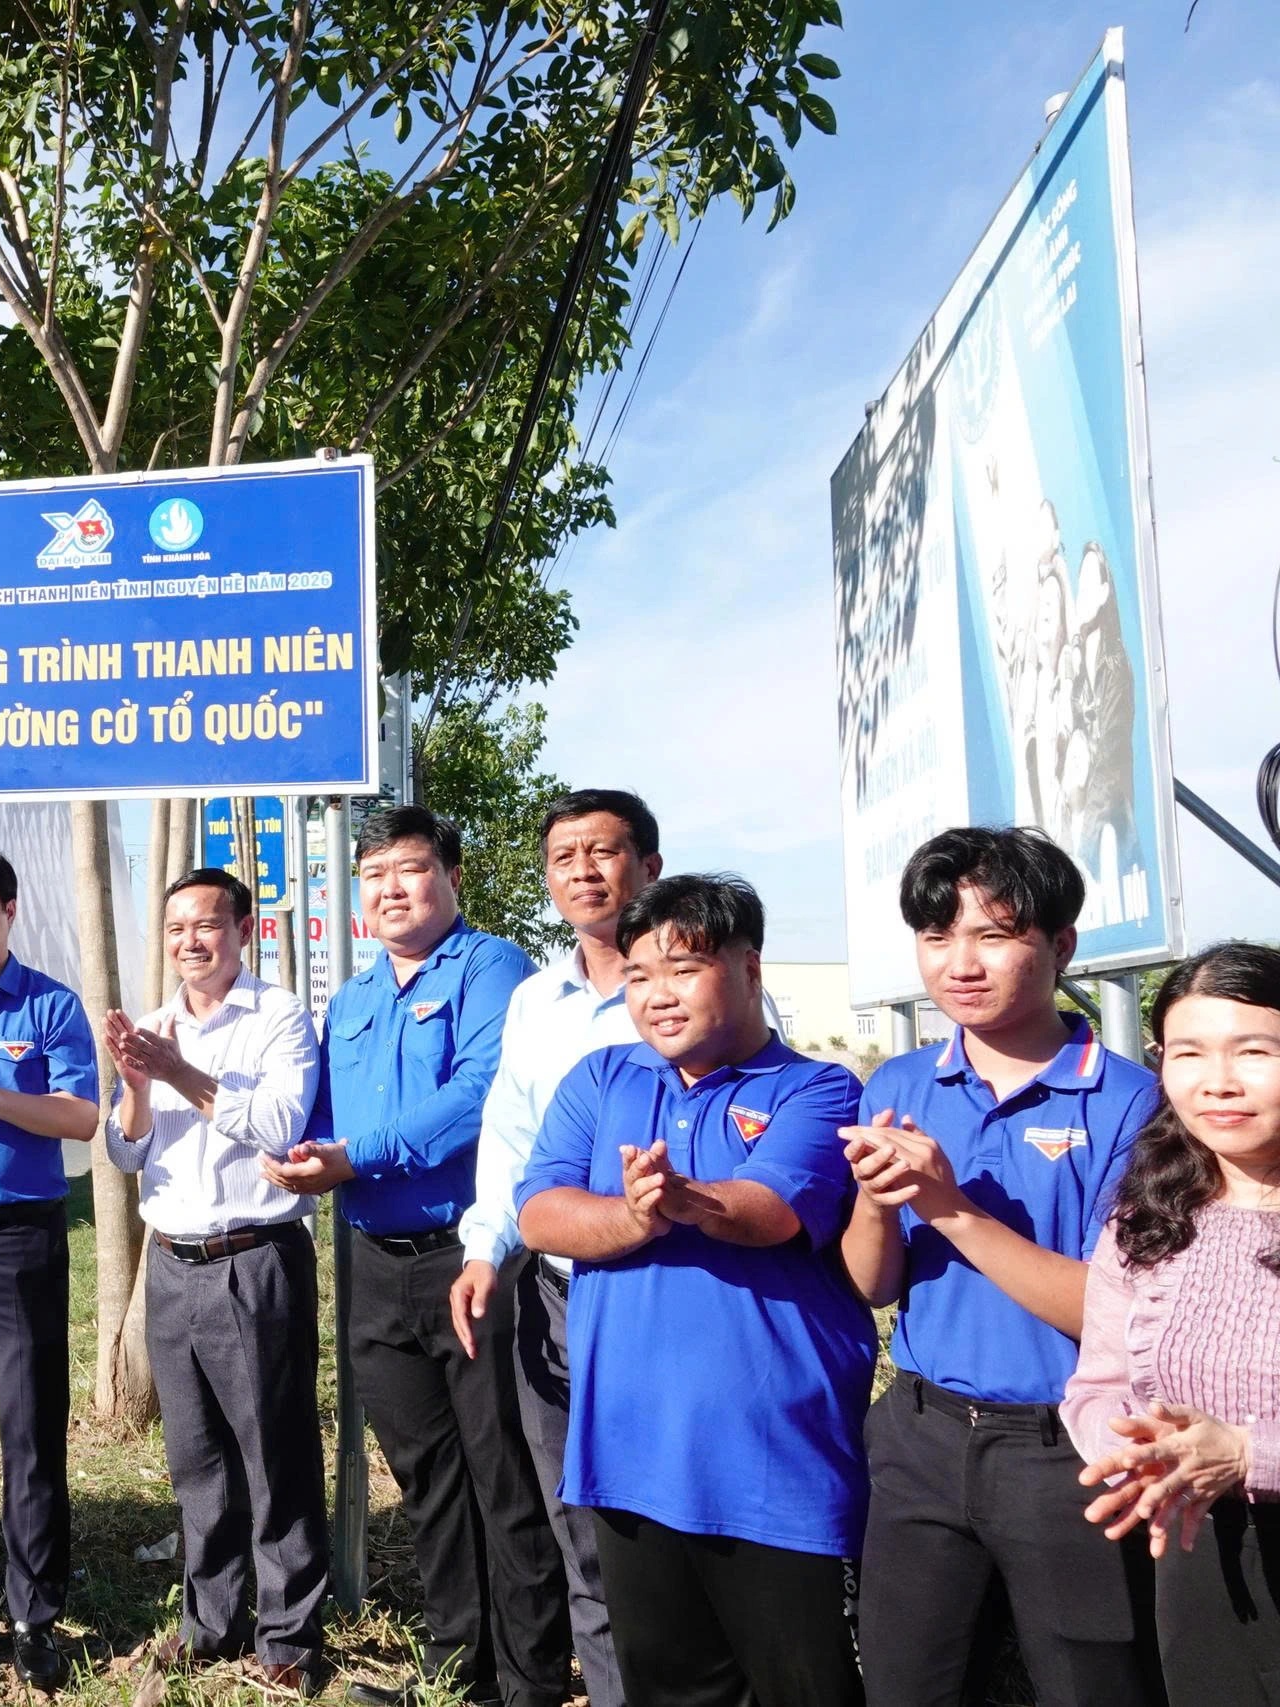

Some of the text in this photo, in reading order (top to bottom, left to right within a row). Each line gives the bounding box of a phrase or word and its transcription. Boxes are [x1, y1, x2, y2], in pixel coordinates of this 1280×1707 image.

[64, 555, 85, 567] HỘI
[89, 554, 110, 564] XIII
[163, 552, 191, 563] KHÁNH
[18, 586, 68, 603] THANH
[74, 581, 109, 599] NIÊN
[155, 576, 218, 598] NGUYỆN
[223, 573, 243, 592] HÈ
[249, 573, 284, 590] NĂM
[290, 573, 331, 589] 2026
[19, 637, 122, 682] TRÌNH
[133, 637, 252, 679] THANH
[264, 626, 354, 673] NIÊN
[91, 698, 139, 745] CỜ
[148, 690, 194, 743] TỔ
[204, 688, 324, 746] QUỐC"
